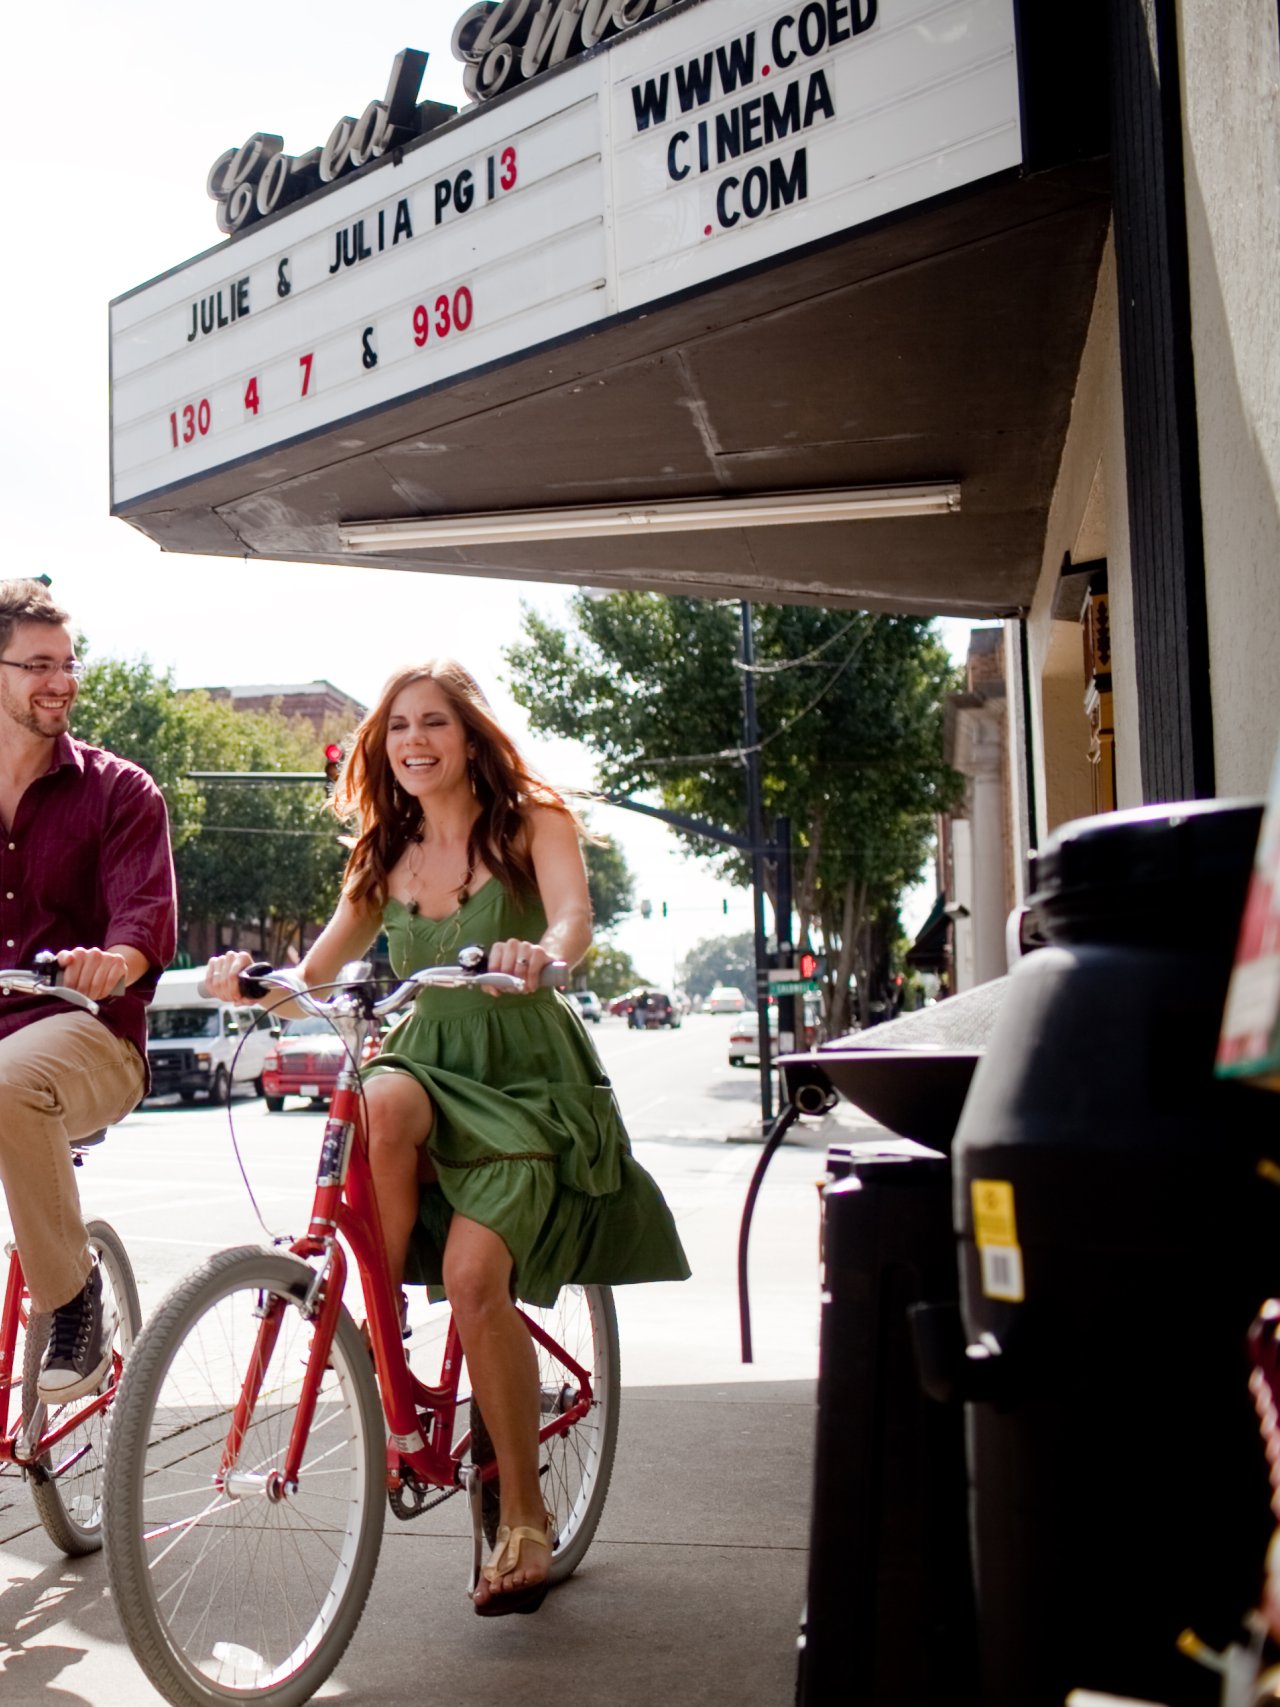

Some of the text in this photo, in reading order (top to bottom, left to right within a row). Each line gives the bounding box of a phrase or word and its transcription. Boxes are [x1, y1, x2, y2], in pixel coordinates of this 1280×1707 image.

[631, 0, 878, 132] WWW.COED
[667, 68, 835, 181] CINEMA
[704, 147, 808, 236] .COM
[187, 276, 250, 342] JULIE
[277, 257, 291, 298] &
[329, 198, 413, 274] JULIA
[170, 286, 473, 448] 130 4 7 & 930
